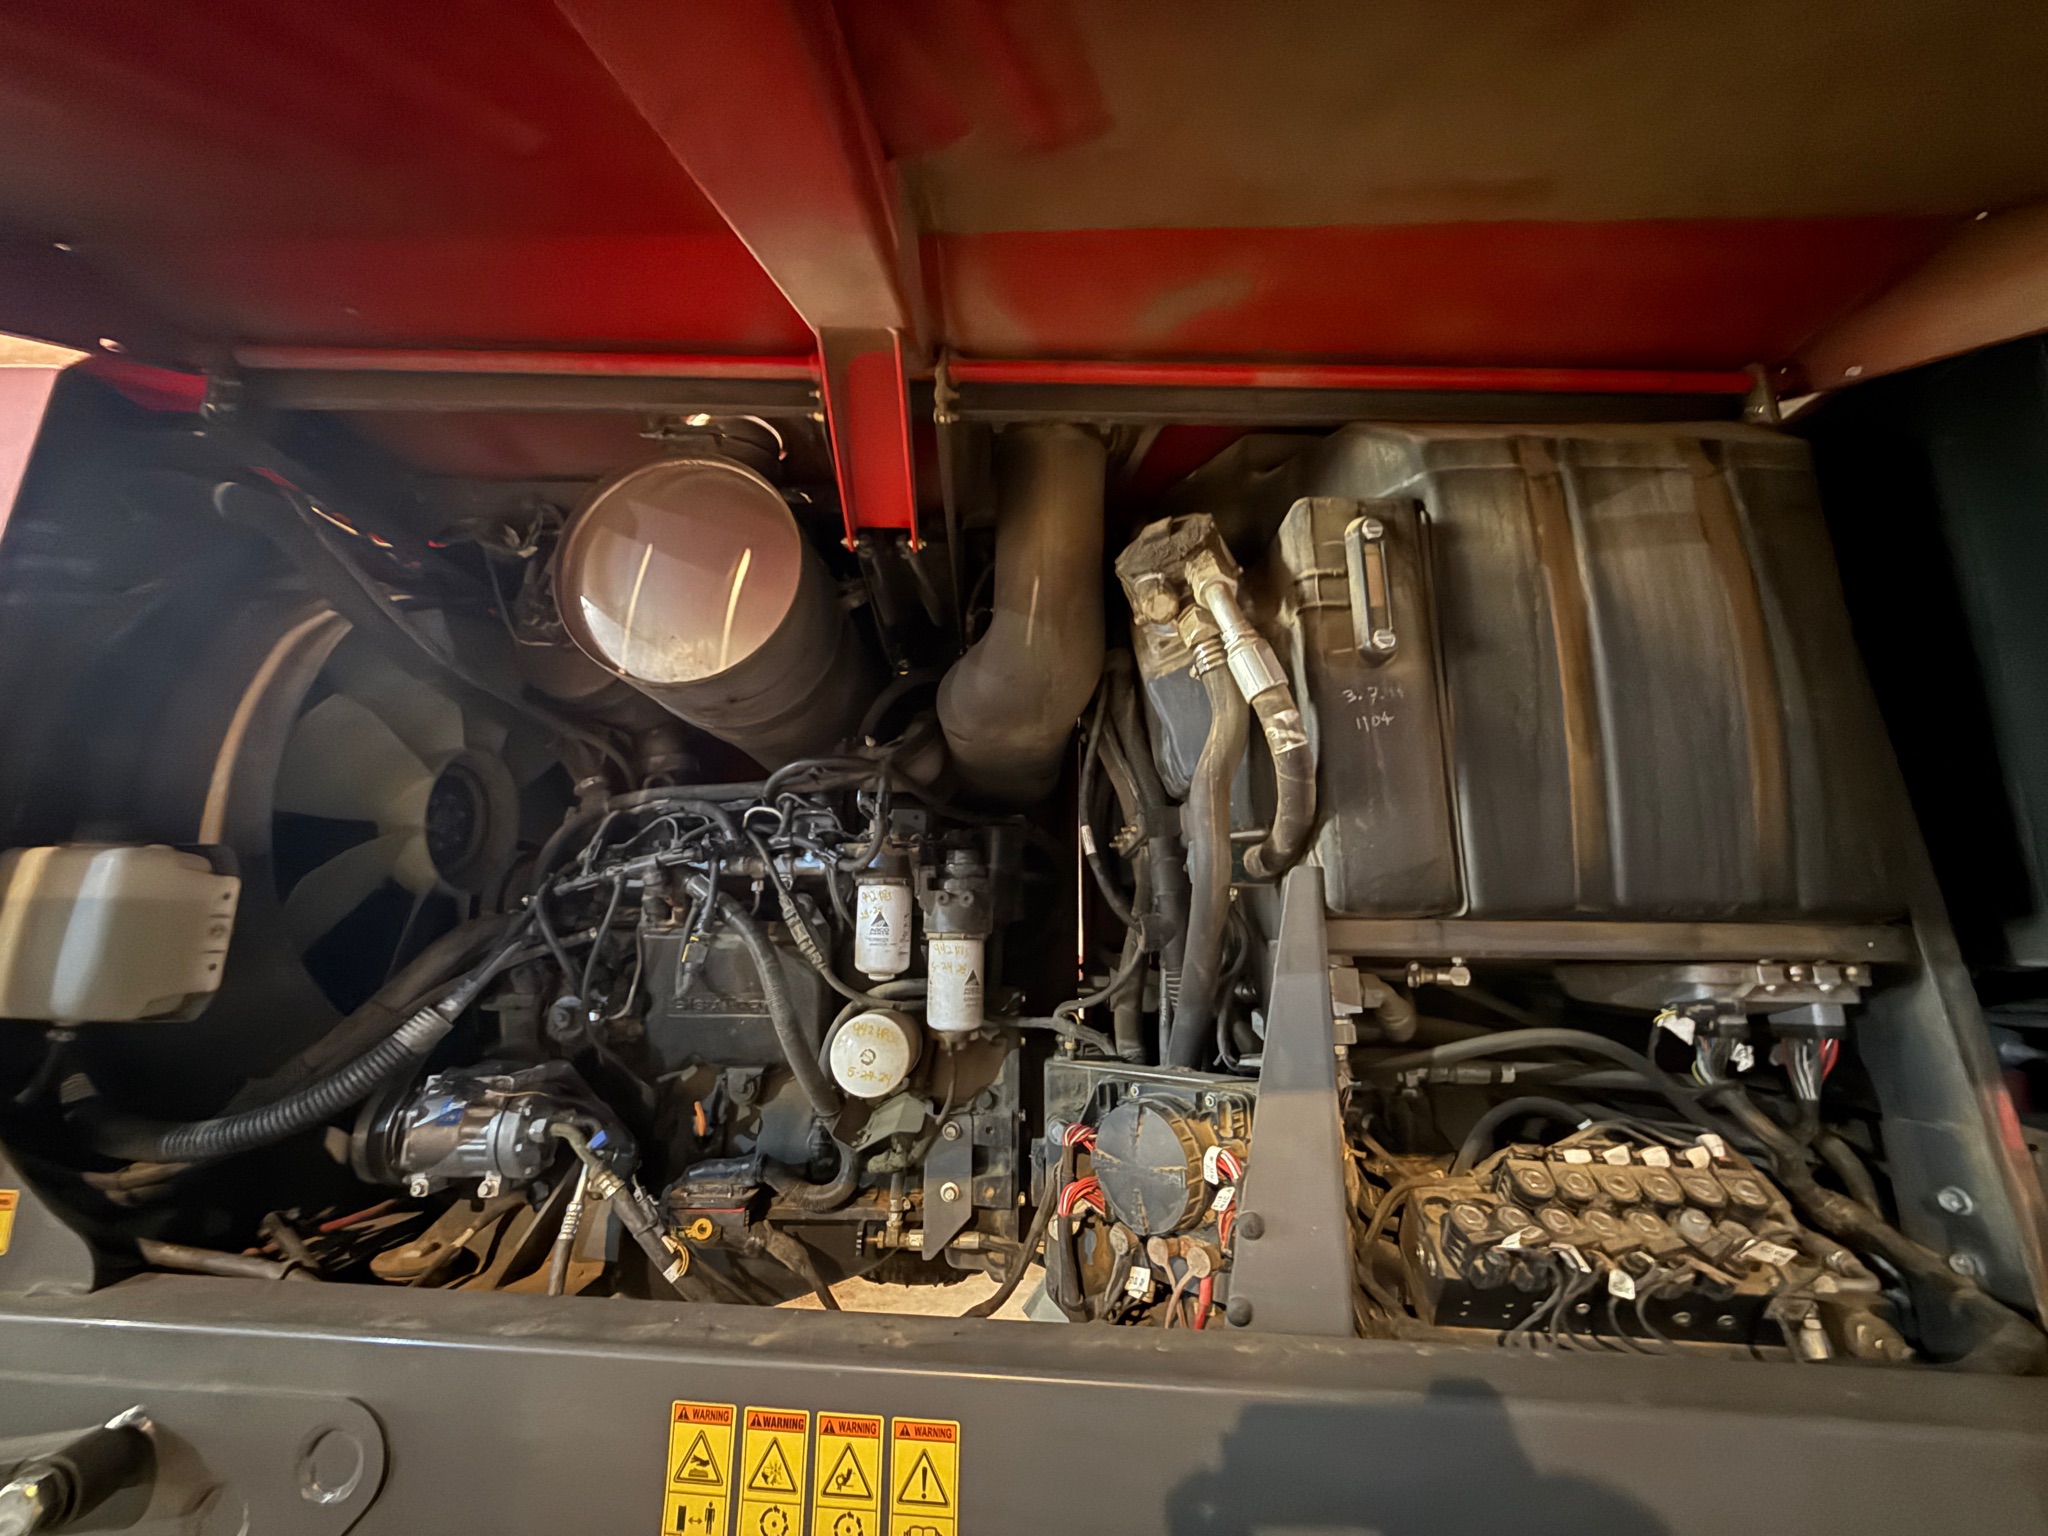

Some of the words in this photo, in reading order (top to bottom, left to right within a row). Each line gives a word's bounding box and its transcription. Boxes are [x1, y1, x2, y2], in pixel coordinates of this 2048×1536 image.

[1355, 710, 1395, 733] 1104
[853, 1022, 874, 1037] 942
[692, 1408, 729, 1422] WARNING
[762, 1415, 804, 1430] WARNING
[838, 1421, 877, 1435] WARNING
[914, 1426, 953, 1439] WARNING
